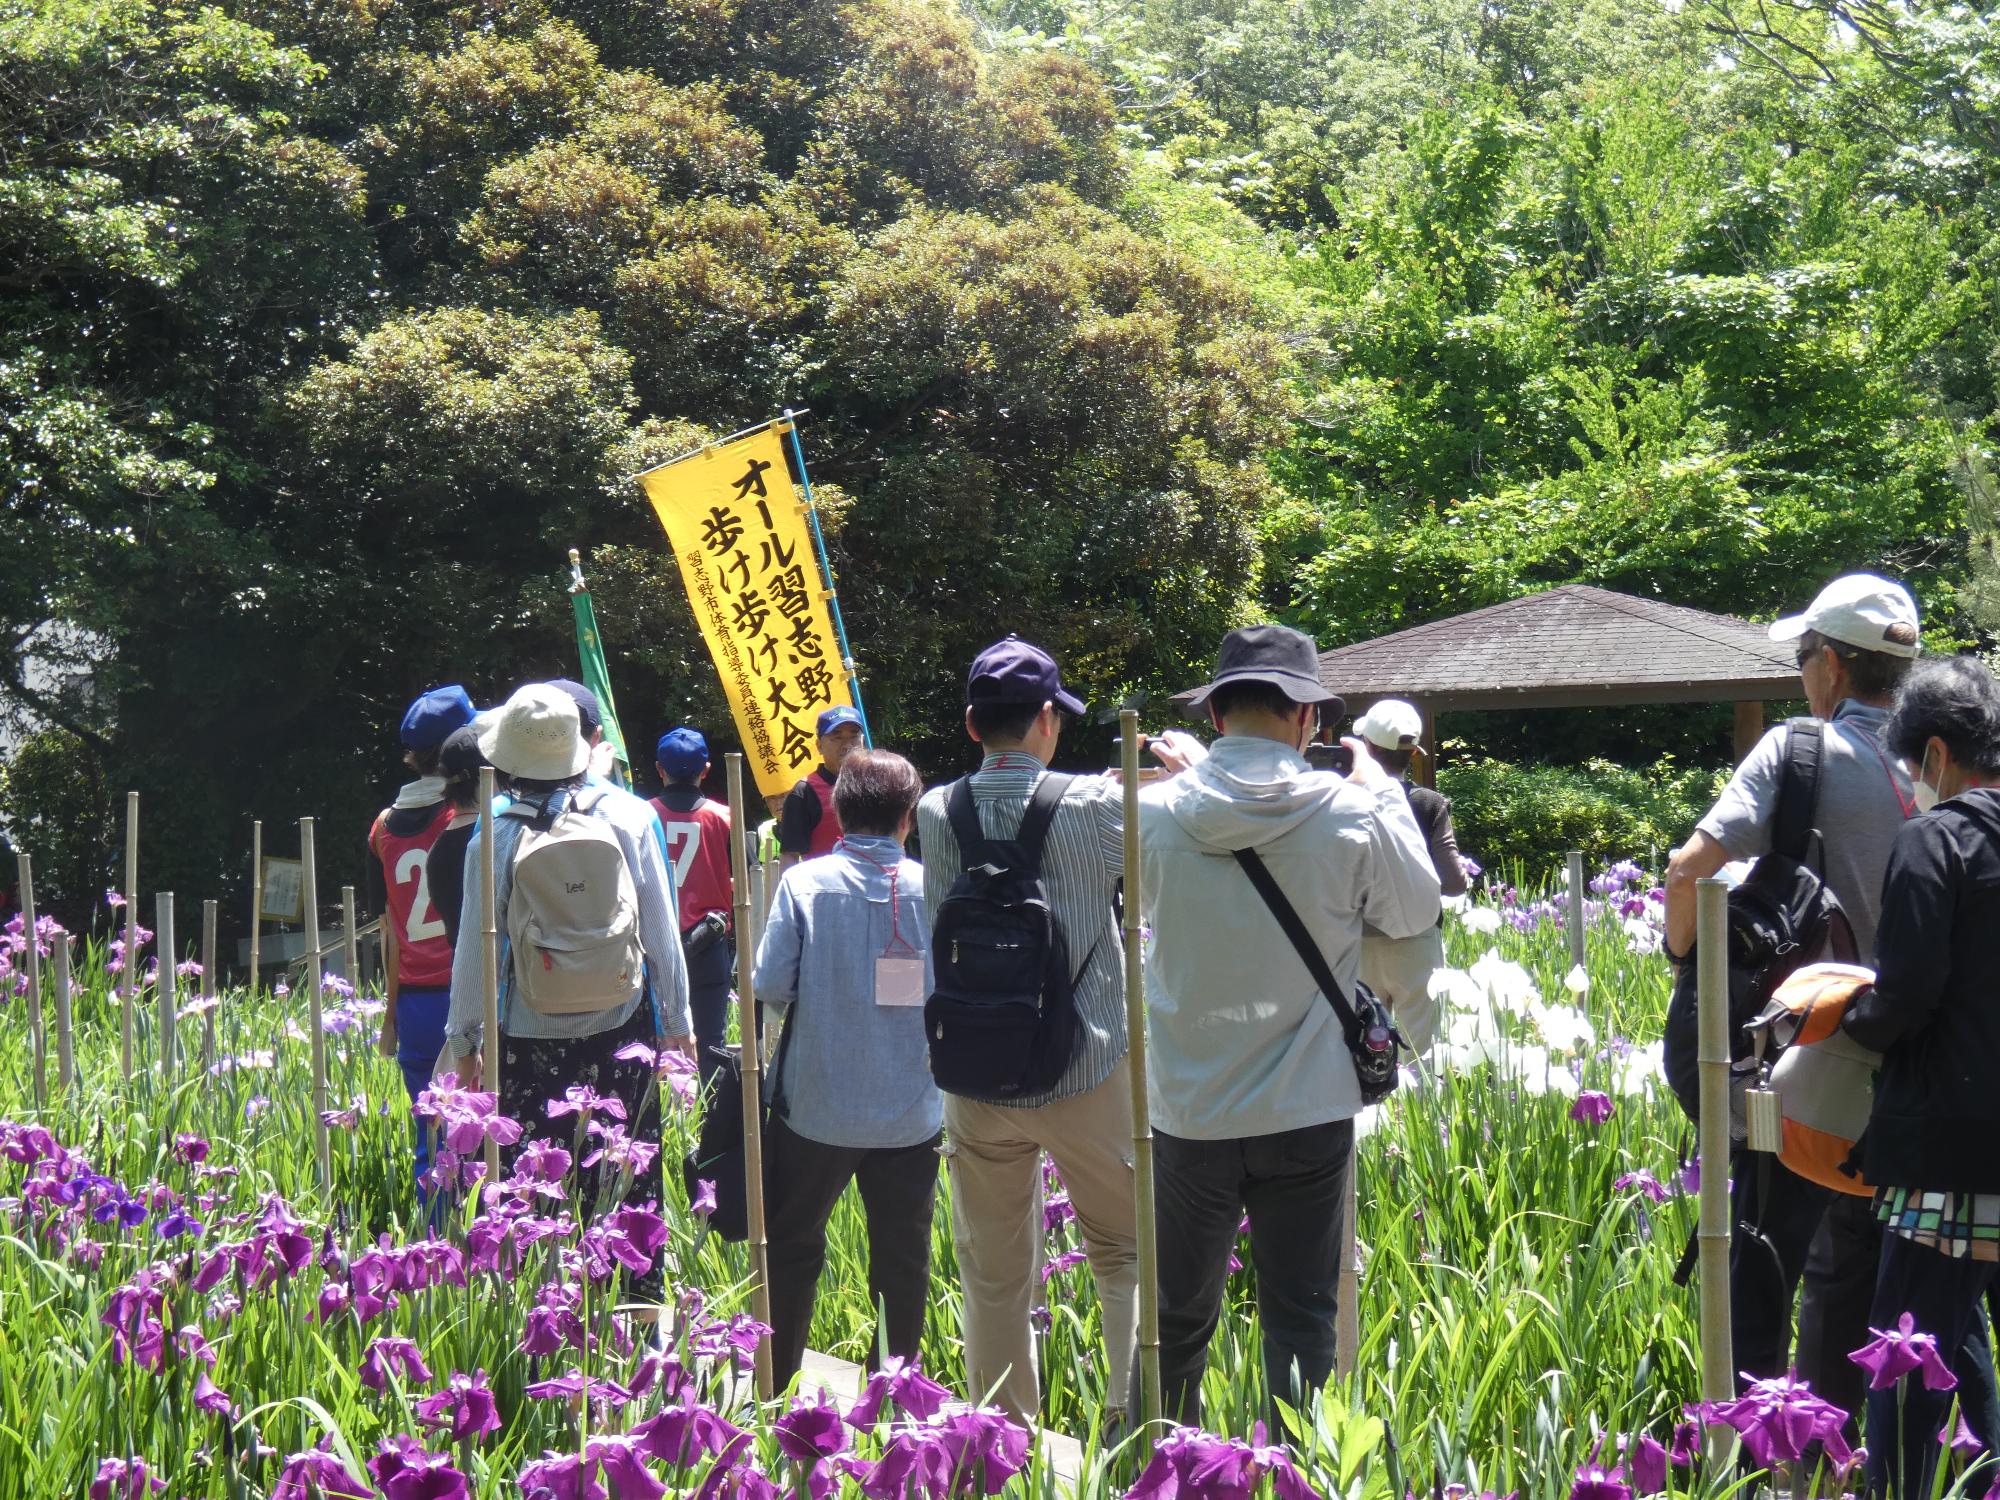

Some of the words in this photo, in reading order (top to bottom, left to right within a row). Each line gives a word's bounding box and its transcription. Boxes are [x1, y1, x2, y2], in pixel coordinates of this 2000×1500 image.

[686, 550, 780, 774] 習志野市体育指導委員連絡協議会
[701, 506, 813, 769] 歩け歩け大会
[731, 459, 834, 711] オール習志野
[395, 848, 446, 942] 2
[565, 882, 585, 894] Lee
[666, 821, 700, 887] 7
